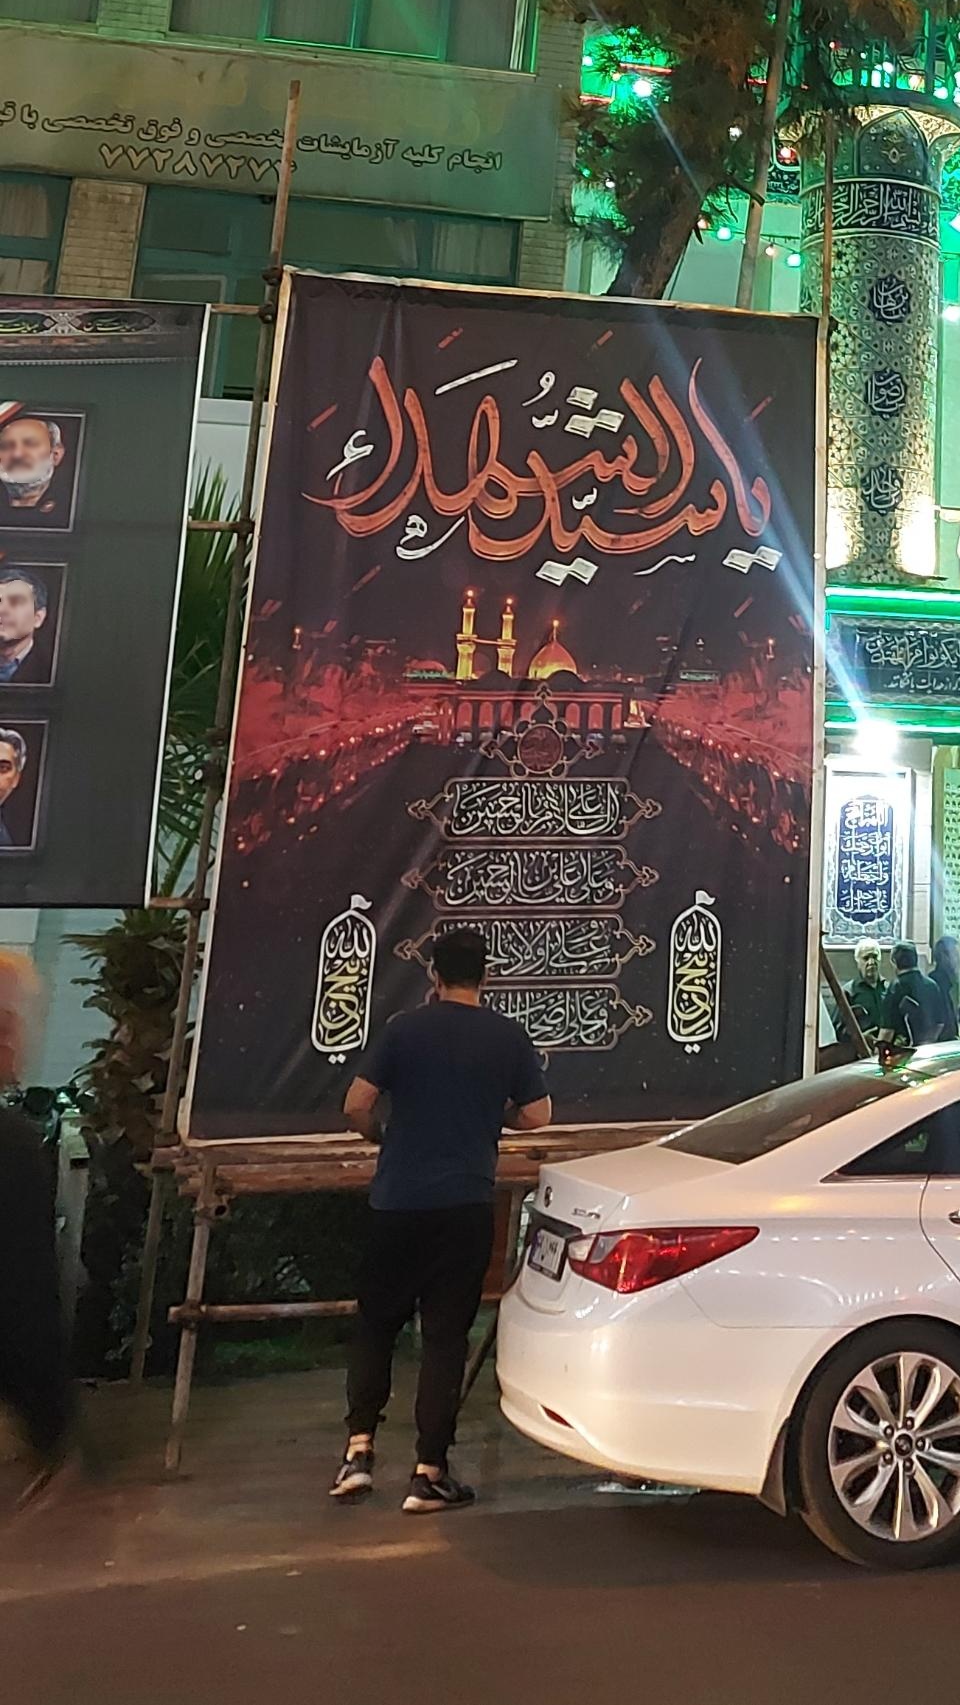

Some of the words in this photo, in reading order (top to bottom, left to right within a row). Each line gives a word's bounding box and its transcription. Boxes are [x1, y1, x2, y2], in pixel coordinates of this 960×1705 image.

[20, 103, 39, 130] با
[42, 113, 136, 133] تخصصی
[137, 117, 183, 142] فوق
[184, 127, 201, 146] و
[205, 128, 285, 149] خصصی
[297, 134, 399, 164] آزمایشات
[402, 144, 444, 166] کلیه
[447, 148, 502, 173] انجام
